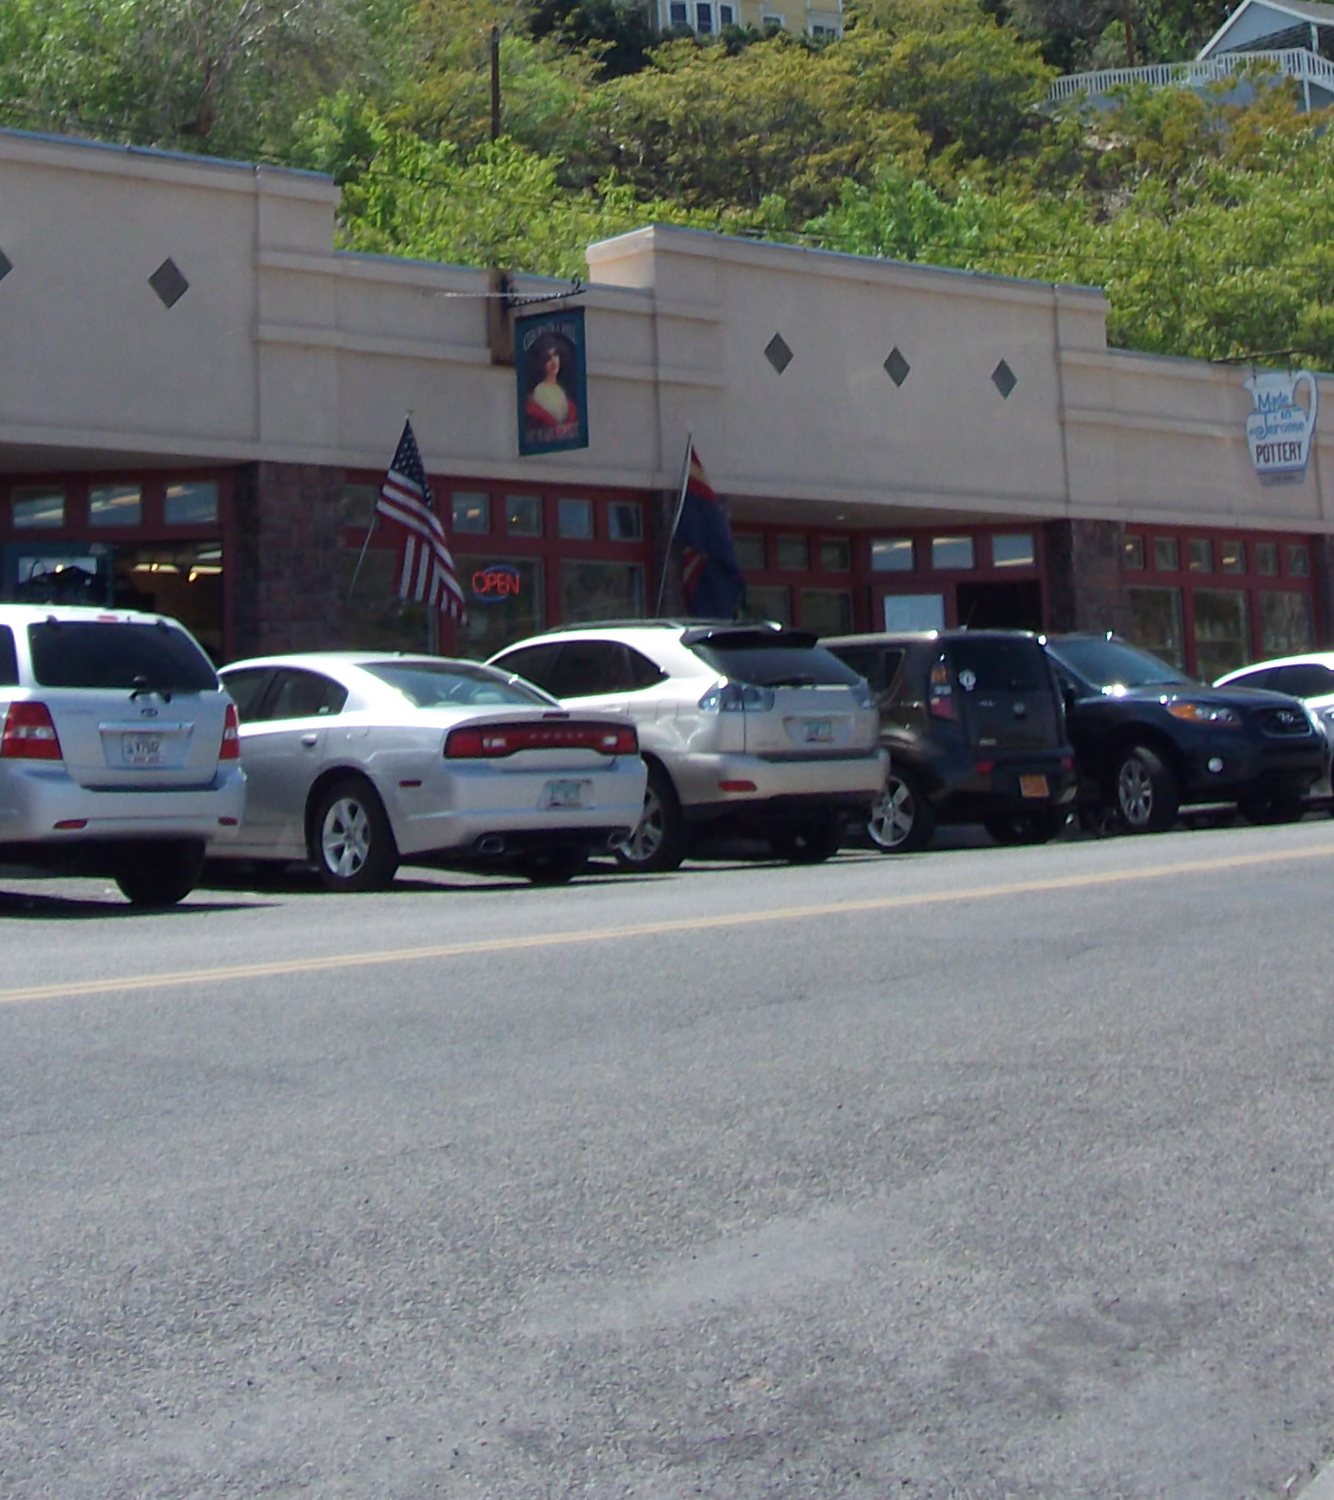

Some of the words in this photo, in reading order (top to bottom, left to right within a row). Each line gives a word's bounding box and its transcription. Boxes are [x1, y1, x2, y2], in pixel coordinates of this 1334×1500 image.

[1258, 391, 1290, 412] Made
[1255, 412, 1306, 441] Jerome
[1255, 441, 1303, 464] POTTERY
[471, 571, 520, 595] OPEN
